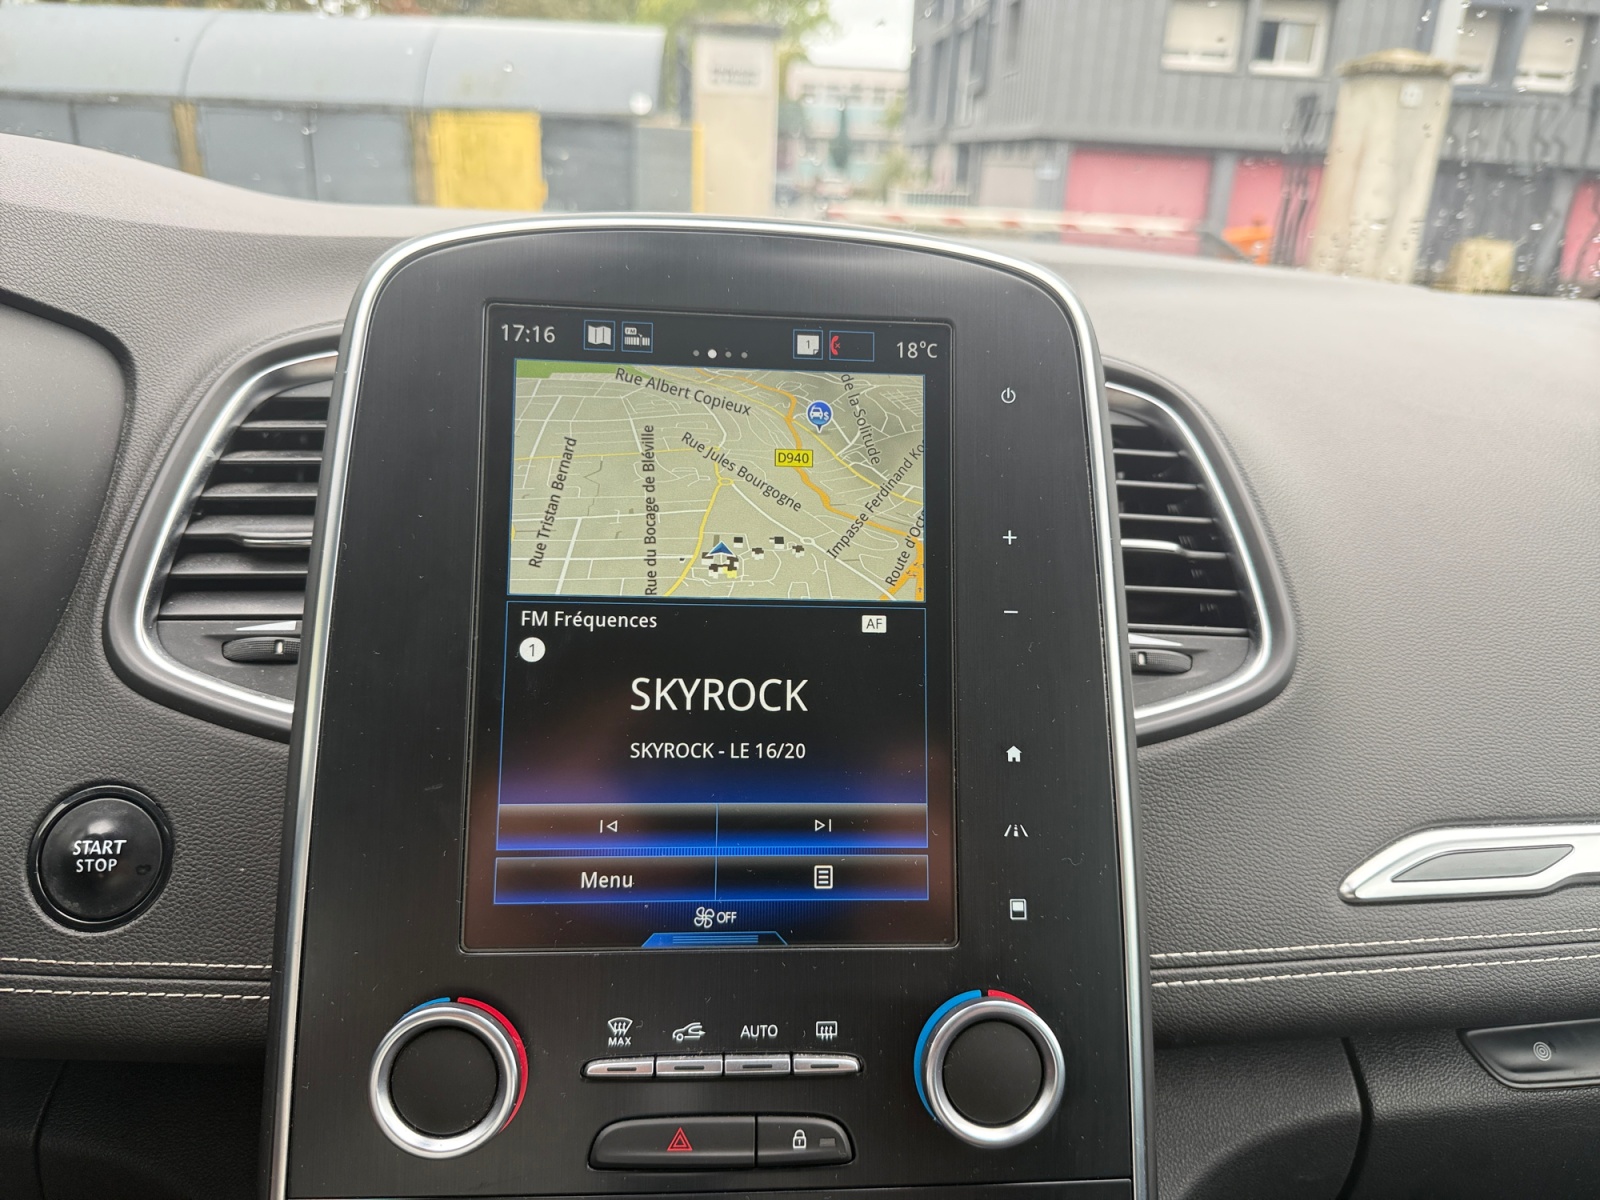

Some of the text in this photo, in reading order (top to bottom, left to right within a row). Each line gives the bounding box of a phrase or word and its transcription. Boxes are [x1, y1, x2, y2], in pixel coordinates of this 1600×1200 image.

[501, 324, 556, 343] 17:16
[896, 340, 938, 359] 18°C
[614, 367, 752, 416] Rue Albert Copieux
[841, 374, 881, 465] de la Solitude
[777, 452, 810, 465] D940
[680, 431, 802, 513] Rue Jules Bourgogne
[528, 436, 577, 569] Rue Tristan Bernard
[826, 438, 924, 560] Impasse Ferdinand Ko
[641, 424, 659, 596] Rue du Bocage de Bléville
[884, 550, 912, 587] Route
[520, 611, 658, 632] FM Fréquences
[866, 618, 883, 630] AF
[630, 677, 809, 712] SKYROCK
[629, 742, 715, 760] SKYROCK
[729, 743, 750, 759] LE
[755, 742, 807, 761] 16/20
[72, 839, 127, 856] START
[76, 857, 118, 873] STOP
[580, 871, 634, 889] Menu
[716, 911, 737, 924] OFF
[740, 1025, 778, 1038] AUTO
[608, 1037, 632, 1047] MAX
